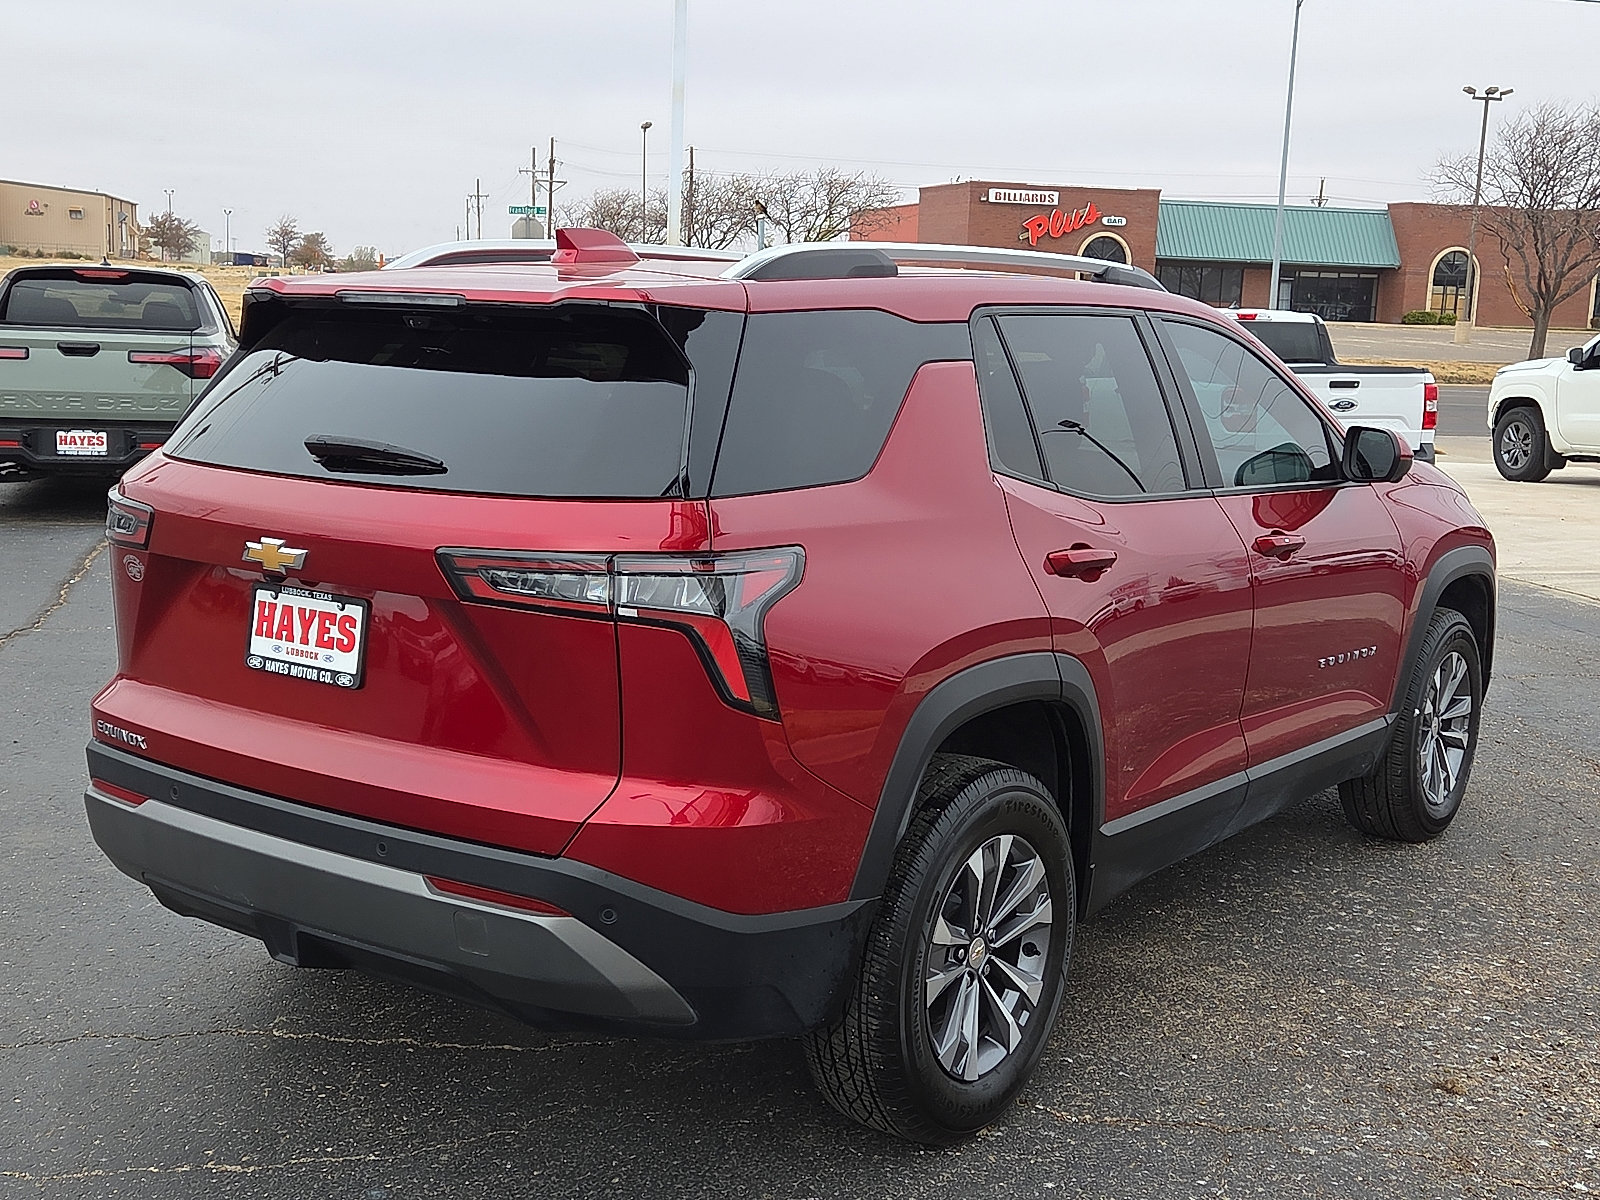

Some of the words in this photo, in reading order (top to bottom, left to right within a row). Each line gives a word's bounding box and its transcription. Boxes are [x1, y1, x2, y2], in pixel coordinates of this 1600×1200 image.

[994, 191, 1056, 204] BILLIARDS
[1022, 202, 1103, 247] Plus
[1106, 217, 1123, 225] BAR
[0, 393, 86, 410] ANTA
[58, 435, 105, 447] HAYES
[313, 592, 333, 601] TEXAS
[254, 599, 358, 654] HAYES
[285, 646, 320, 661] LUBBOCK
[1318, 645, 1377, 669] EQUINOX
[264, 660, 289, 675] HAYES
[290, 664, 318, 681] MOTOR
[319, 670, 334, 684] CO.
[97, 719, 147, 750] EQUINOX
[1003, 799, 1060, 839] Firestone
